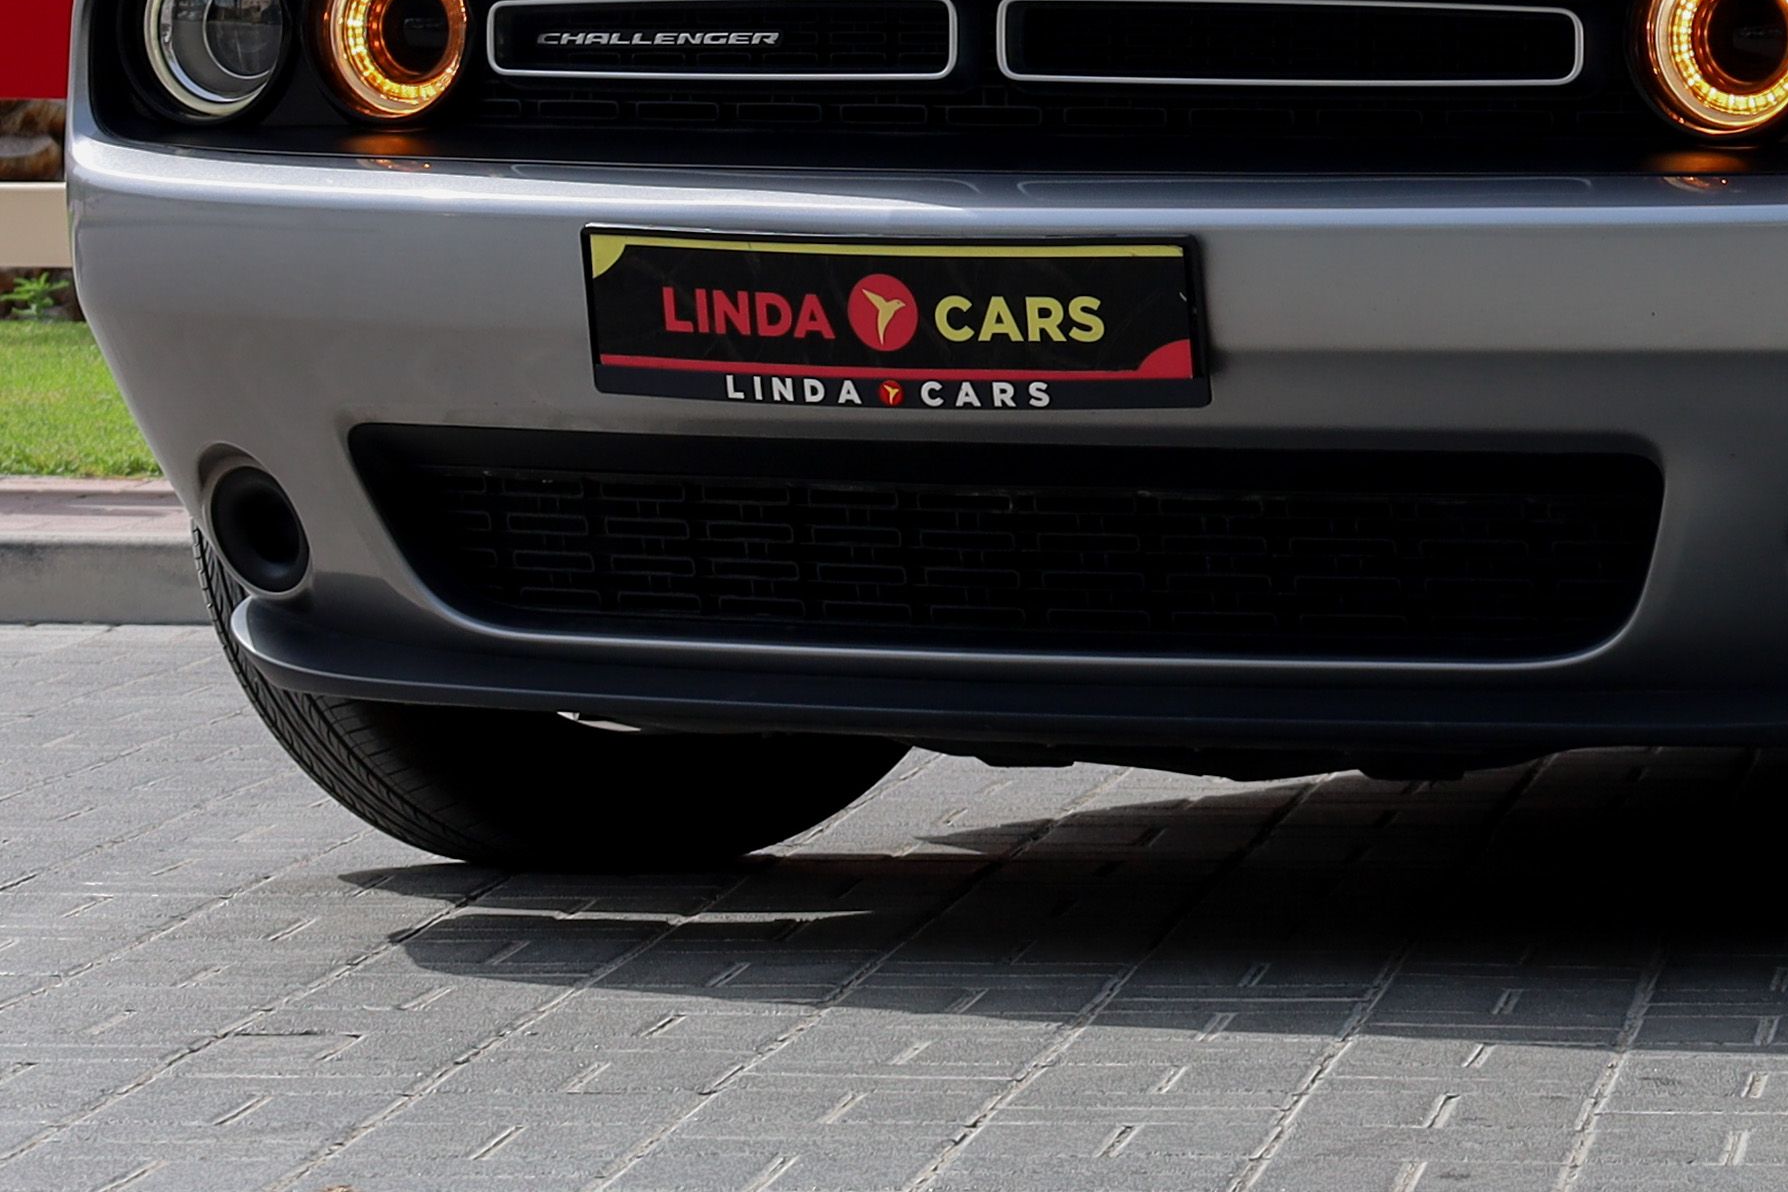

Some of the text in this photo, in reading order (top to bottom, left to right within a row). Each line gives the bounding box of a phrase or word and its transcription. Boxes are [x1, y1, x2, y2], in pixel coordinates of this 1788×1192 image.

[537, 31, 781, 46] CHALLENGER
[662, 286, 1105, 343] LINDA CARS
[725, 374, 1051, 408] LINDA CARS
